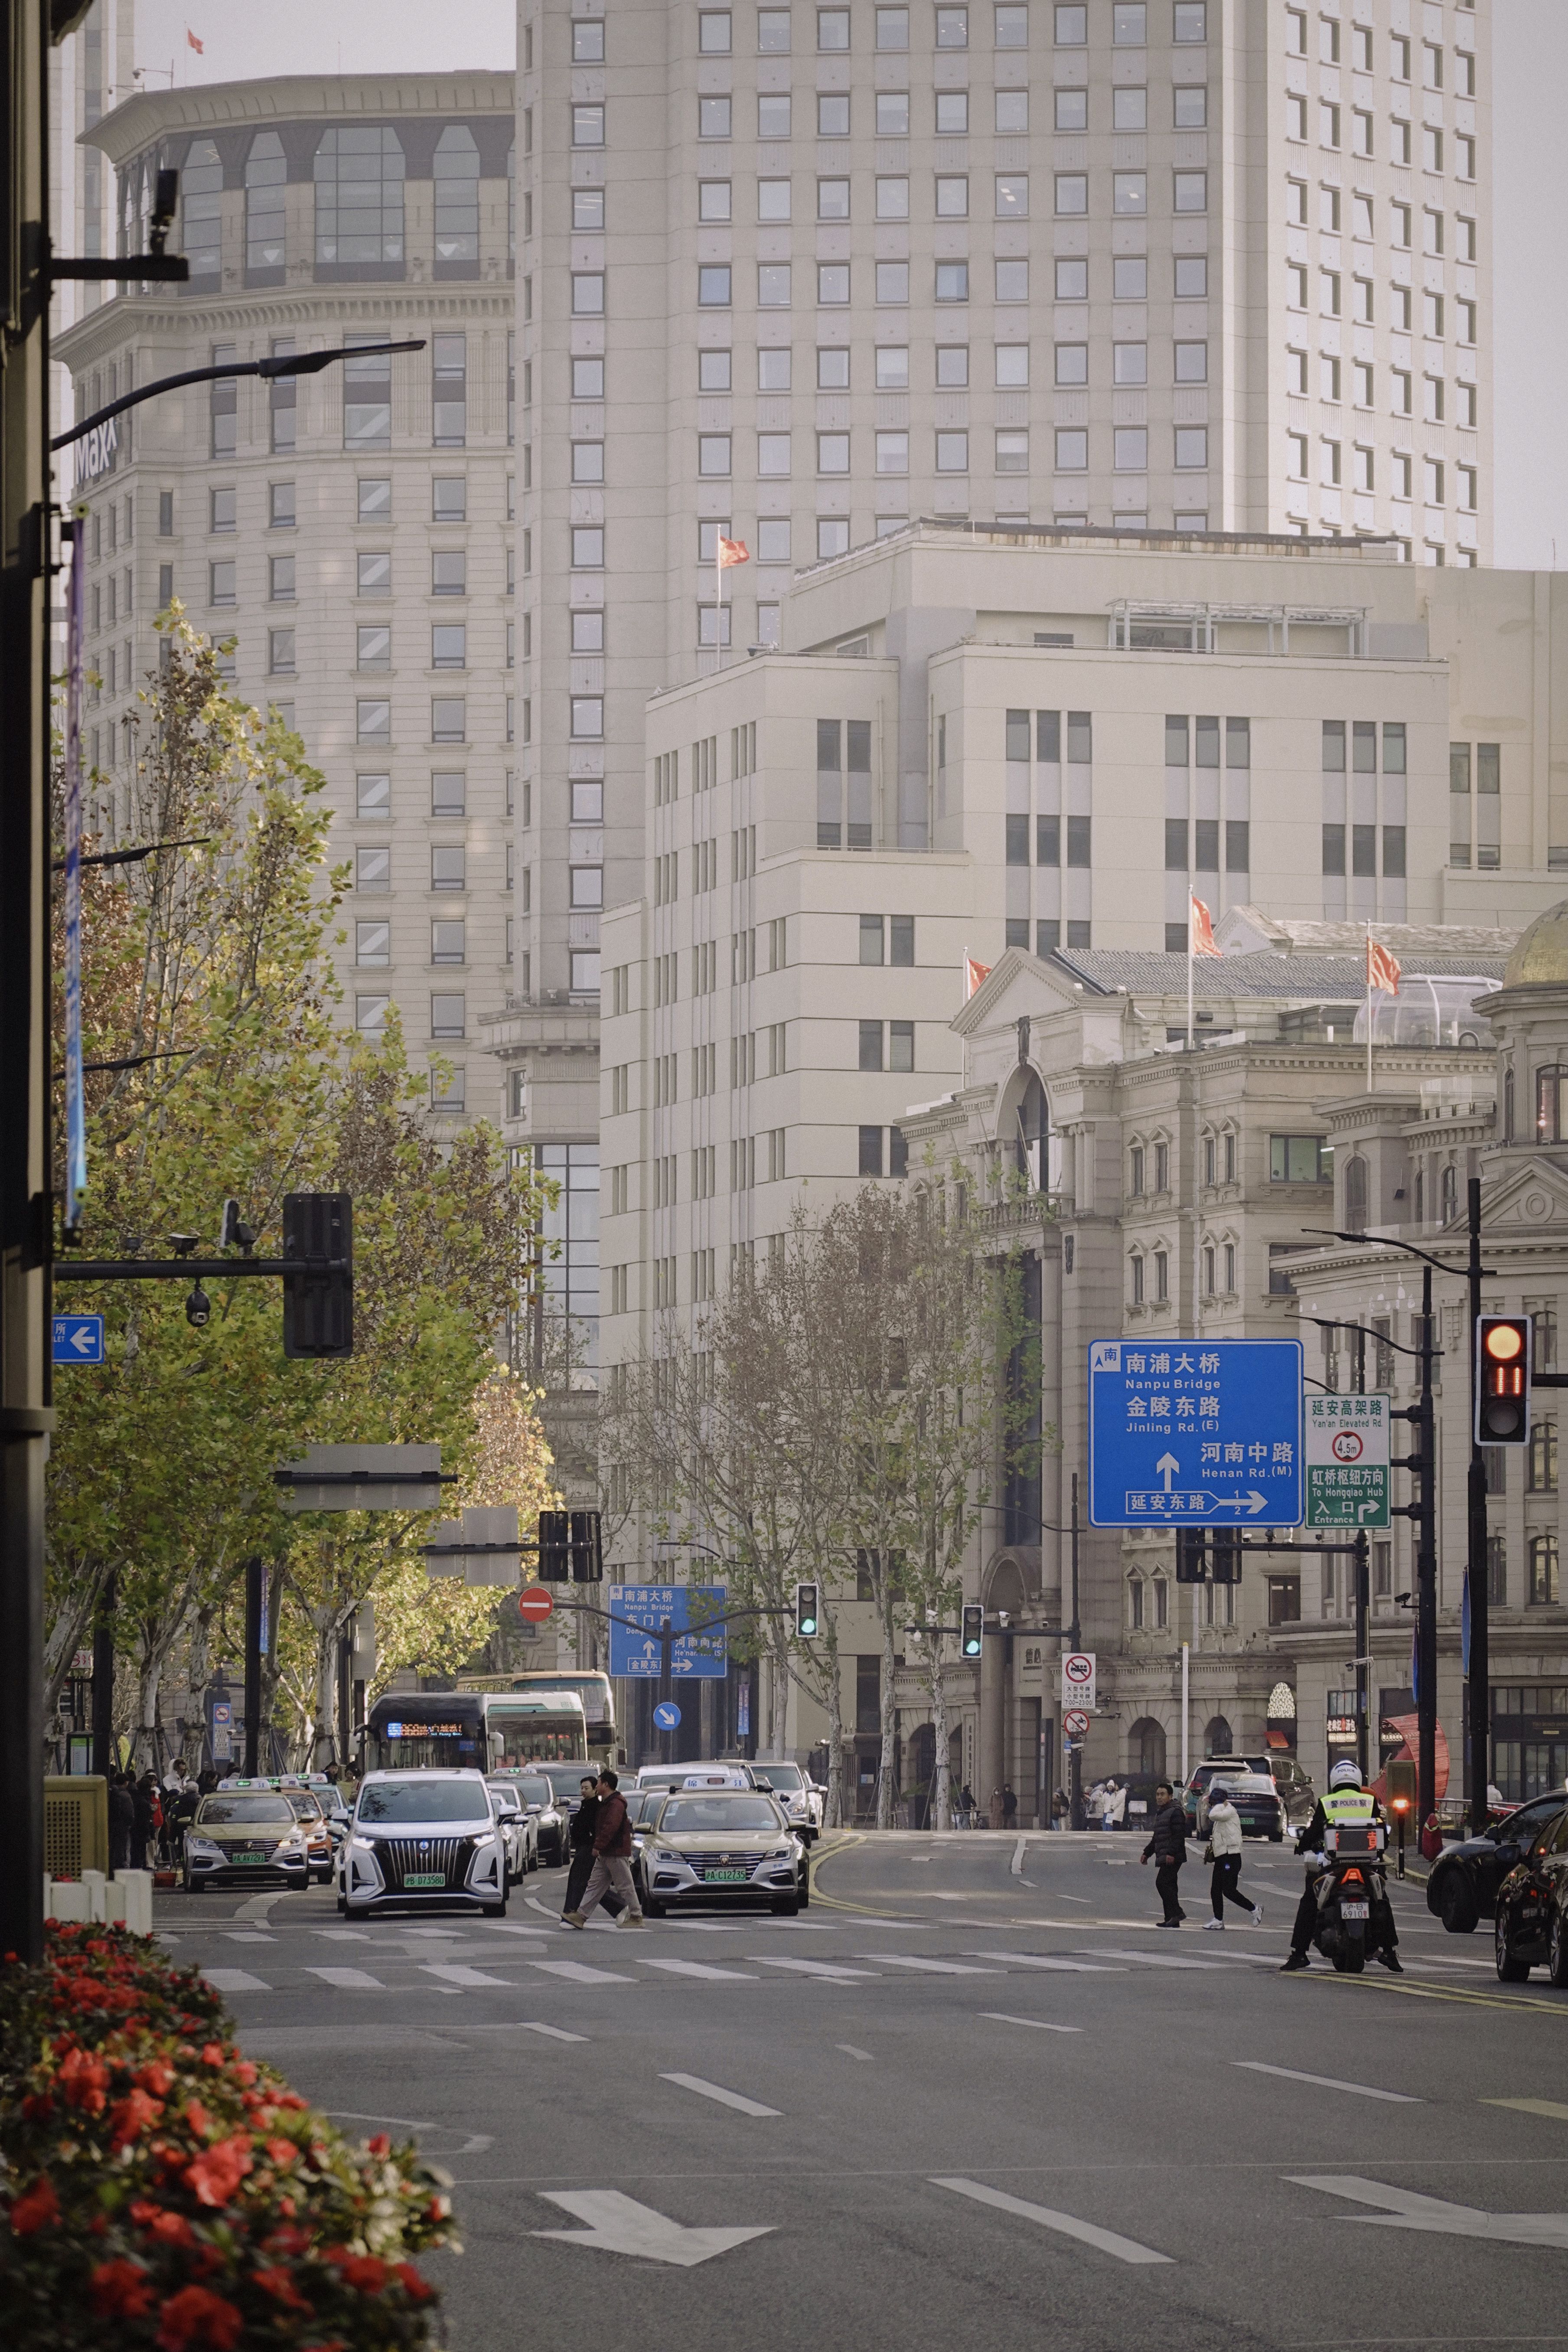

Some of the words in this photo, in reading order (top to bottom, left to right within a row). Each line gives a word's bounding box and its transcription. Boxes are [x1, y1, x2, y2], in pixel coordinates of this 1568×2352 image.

[1104, 1348, 1117, 1361] 南
[1126, 1353, 1221, 1374] 南浦大桥
[1126, 1379, 1170, 1391] Nanpu
[1174, 1378, 1221, 1390] Bridge
[1497, 1367, 1521, 1395] 11
[1126, 1396, 1221, 1417] 金陵东路
[1312, 1399, 1382, 1416] 延安高架路
[1126, 1422, 1171, 1434] Jinling
[1178, 1422, 1199, 1432] Rd.
[1201, 1419, 1219, 1432] (E)
[1313, 1419, 1336, 1428] Yan'an
[1340, 1419, 1369, 1428] Elevated
[1373, 1419, 1383, 1428] Rd.
[1200, 1441, 1294, 1464] 河南中路
[1337, 1440, 1357, 1455] 4.5m
[1202, 1468, 1244, 1478] Henan
[1312, 1468, 1384, 1486] 虹桥枢纽方向
[1234, 1490, 1240, 1499] 1
[1312, 1488, 1321, 1497] To
[1326, 1487, 1363, 1499] Hongqiao
[1367, 1487, 1383, 1497] Hub
[1131, 1494, 1205, 1510] 延安东路
[1315, 1500, 1354, 1515] 入口
[1234, 1506, 1241, 1516] 2
[624, 1590, 673, 1602] 南浦大桥
[651, 1604, 674, 1612] Bridge
[1359, 1799, 1366, 1807] 察
